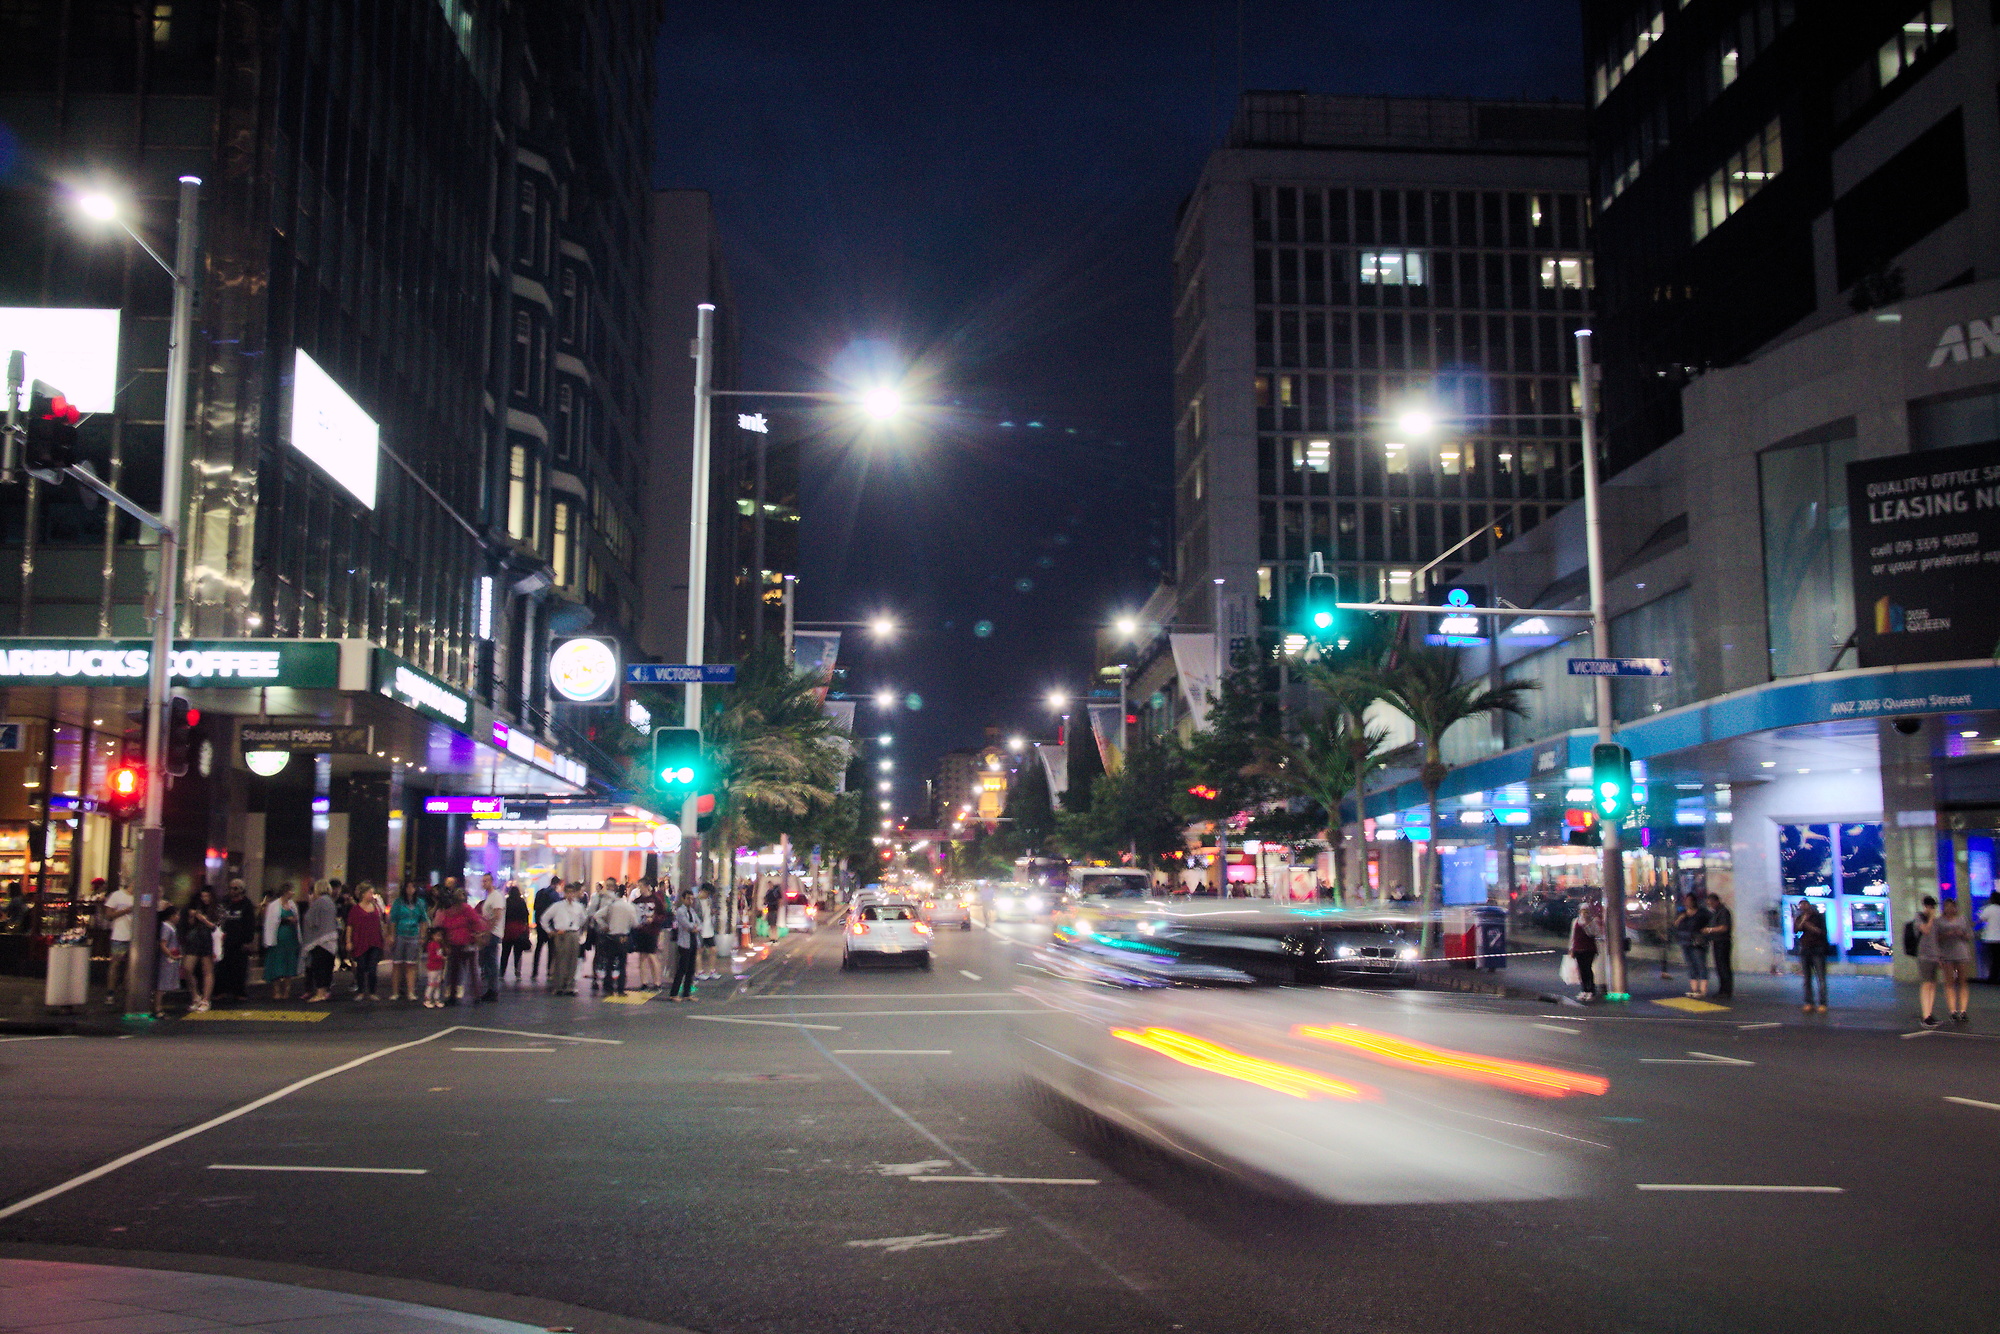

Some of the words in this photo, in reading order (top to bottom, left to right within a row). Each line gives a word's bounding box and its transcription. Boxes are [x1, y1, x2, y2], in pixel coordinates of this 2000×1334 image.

[1866, 476, 1928, 499] QUALITY
[1930, 468, 1980, 489] OFFICE
[1868, 490, 1969, 524] LEASING
[1869, 542, 1893, 558] call
[1871, 563, 1886, 576] or
[1887, 560, 1918, 575] your
[1920, 551, 1980, 573] preferred
[1905, 618, 1951, 633] QUEEN
[655, 667, 704, 681] VICTORIA
[1572, 661, 1619, 675] VICTORIA
[1881, 697, 1928, 710] Queen
[1928, 694, 1972, 708] Street
[242, 729, 290, 742] Student
[291, 728, 333, 744] Flights
